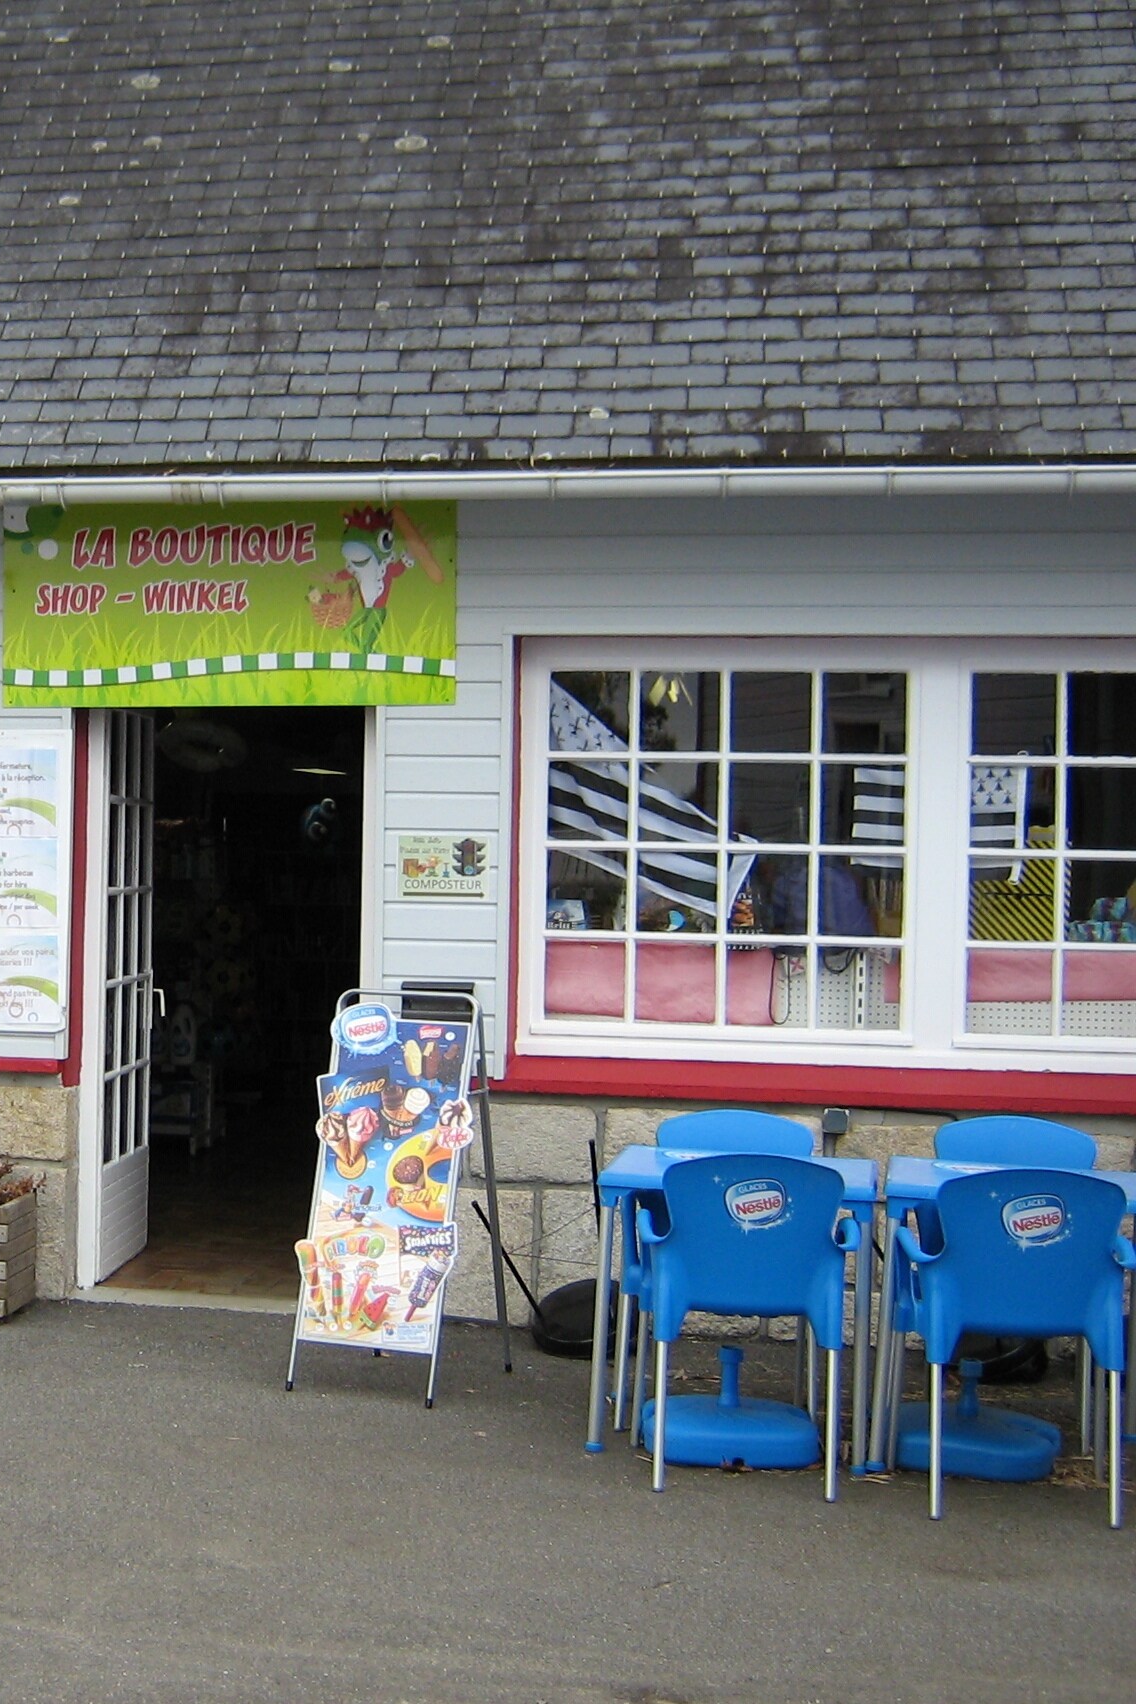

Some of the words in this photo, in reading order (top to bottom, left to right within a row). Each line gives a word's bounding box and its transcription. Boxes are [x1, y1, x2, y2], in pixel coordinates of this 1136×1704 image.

[72, 526, 117, 570] LA
[127, 521, 316, 567] BOUTIQUE
[35, 582, 107, 616] SHOP
[142, 579, 250, 616] WINKEL
[404, 879, 482, 890] COMPOSTEUR
[348, 1020, 386, 1038] Nestlé
[735, 1195, 781, 1216] Nestlé
[1011, 1211, 1060, 1233] Nestlé
